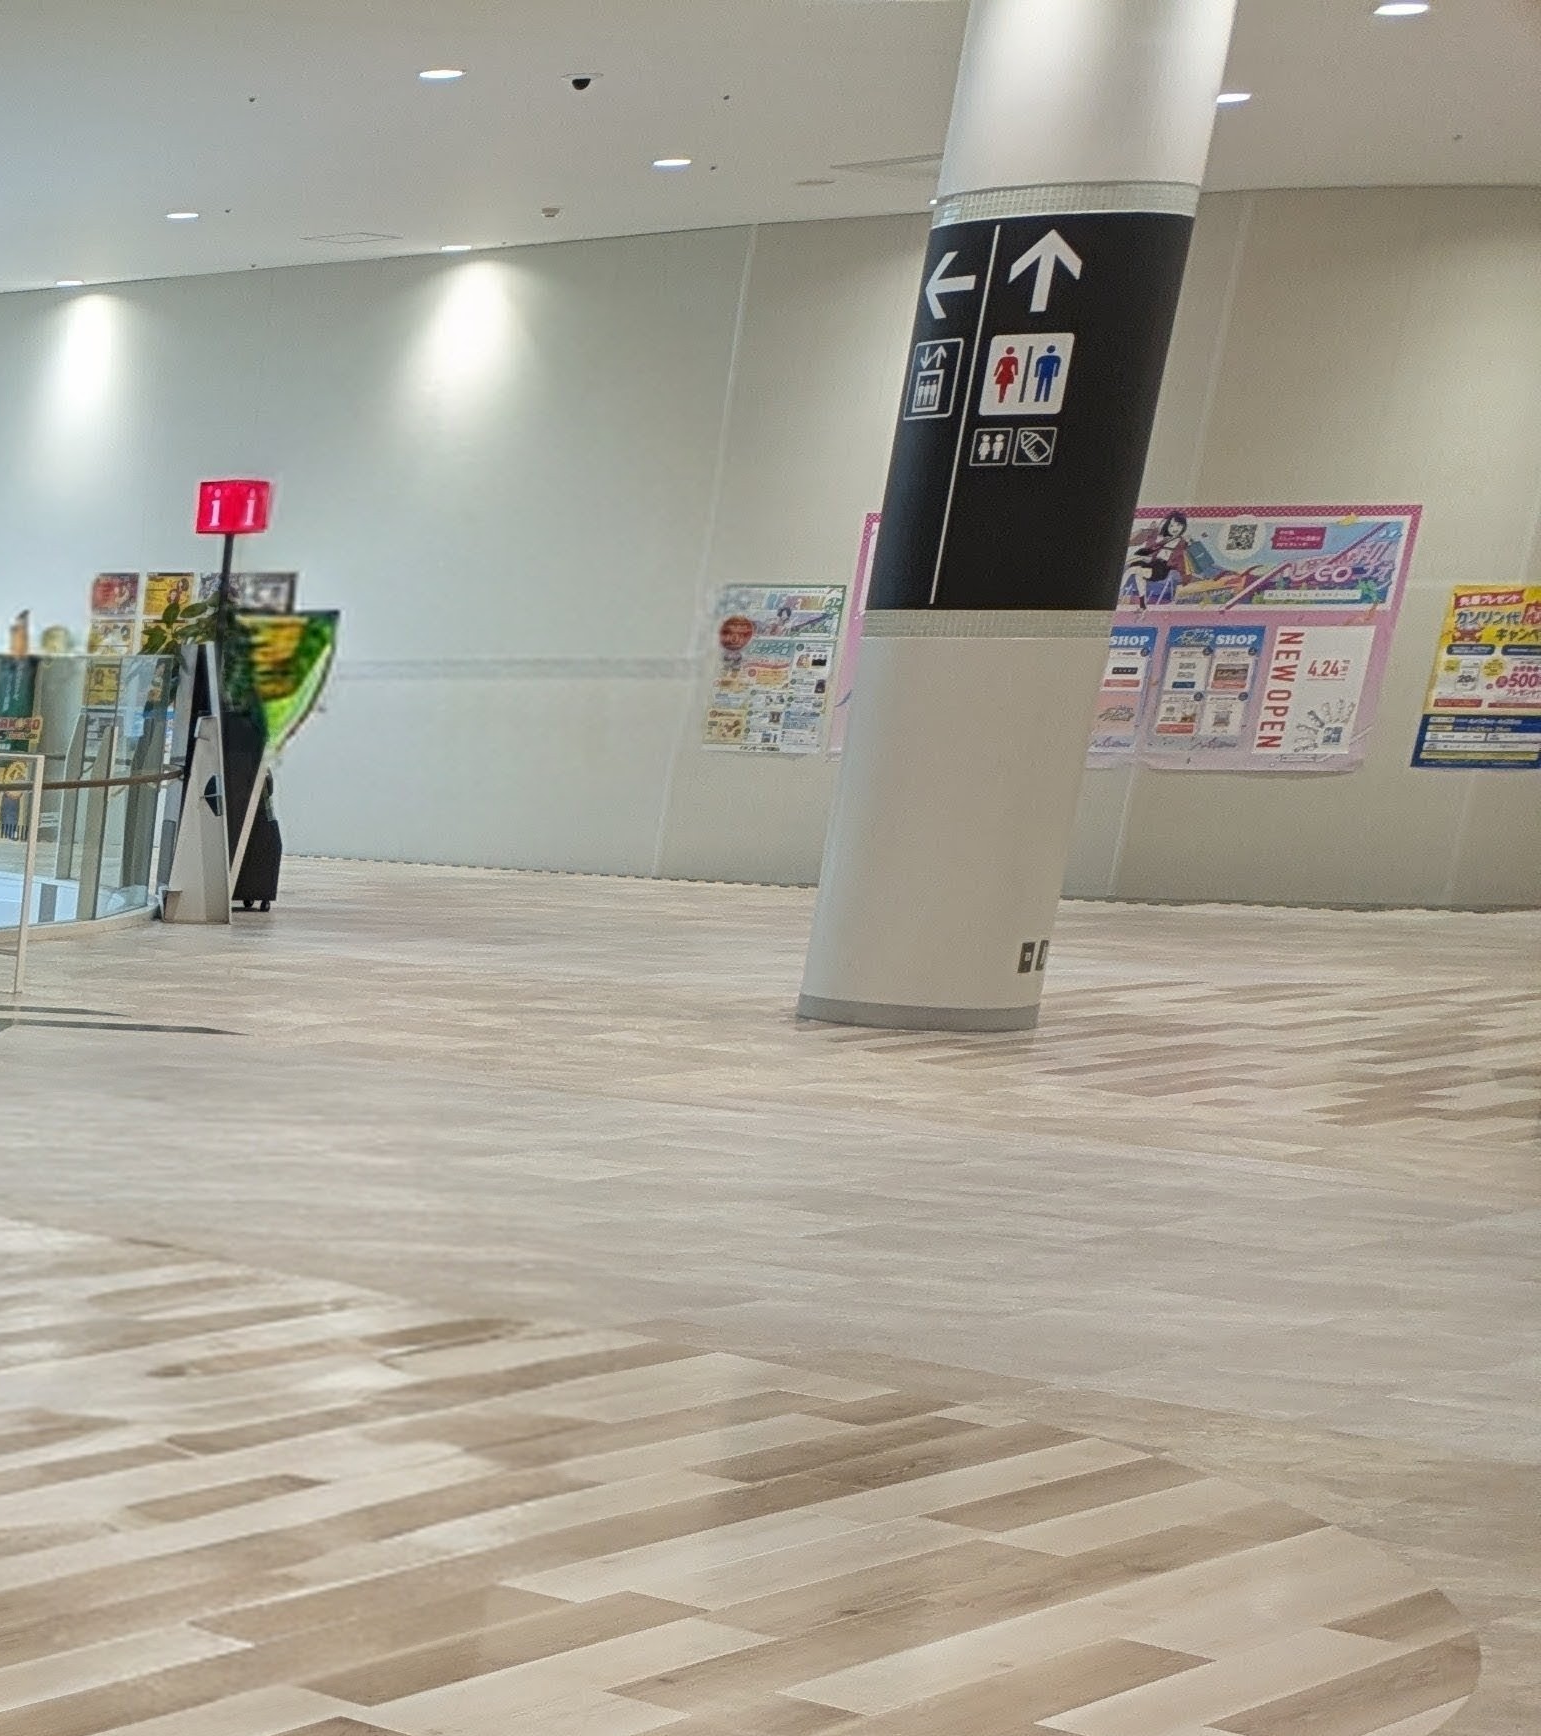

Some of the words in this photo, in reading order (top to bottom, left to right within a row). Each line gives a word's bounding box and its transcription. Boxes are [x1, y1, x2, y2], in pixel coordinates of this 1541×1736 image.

[1215, 633, 1258, 646] SHOP
[1270, 631, 1305, 683] NEW
[1255, 689, 1292, 748] OPEN
